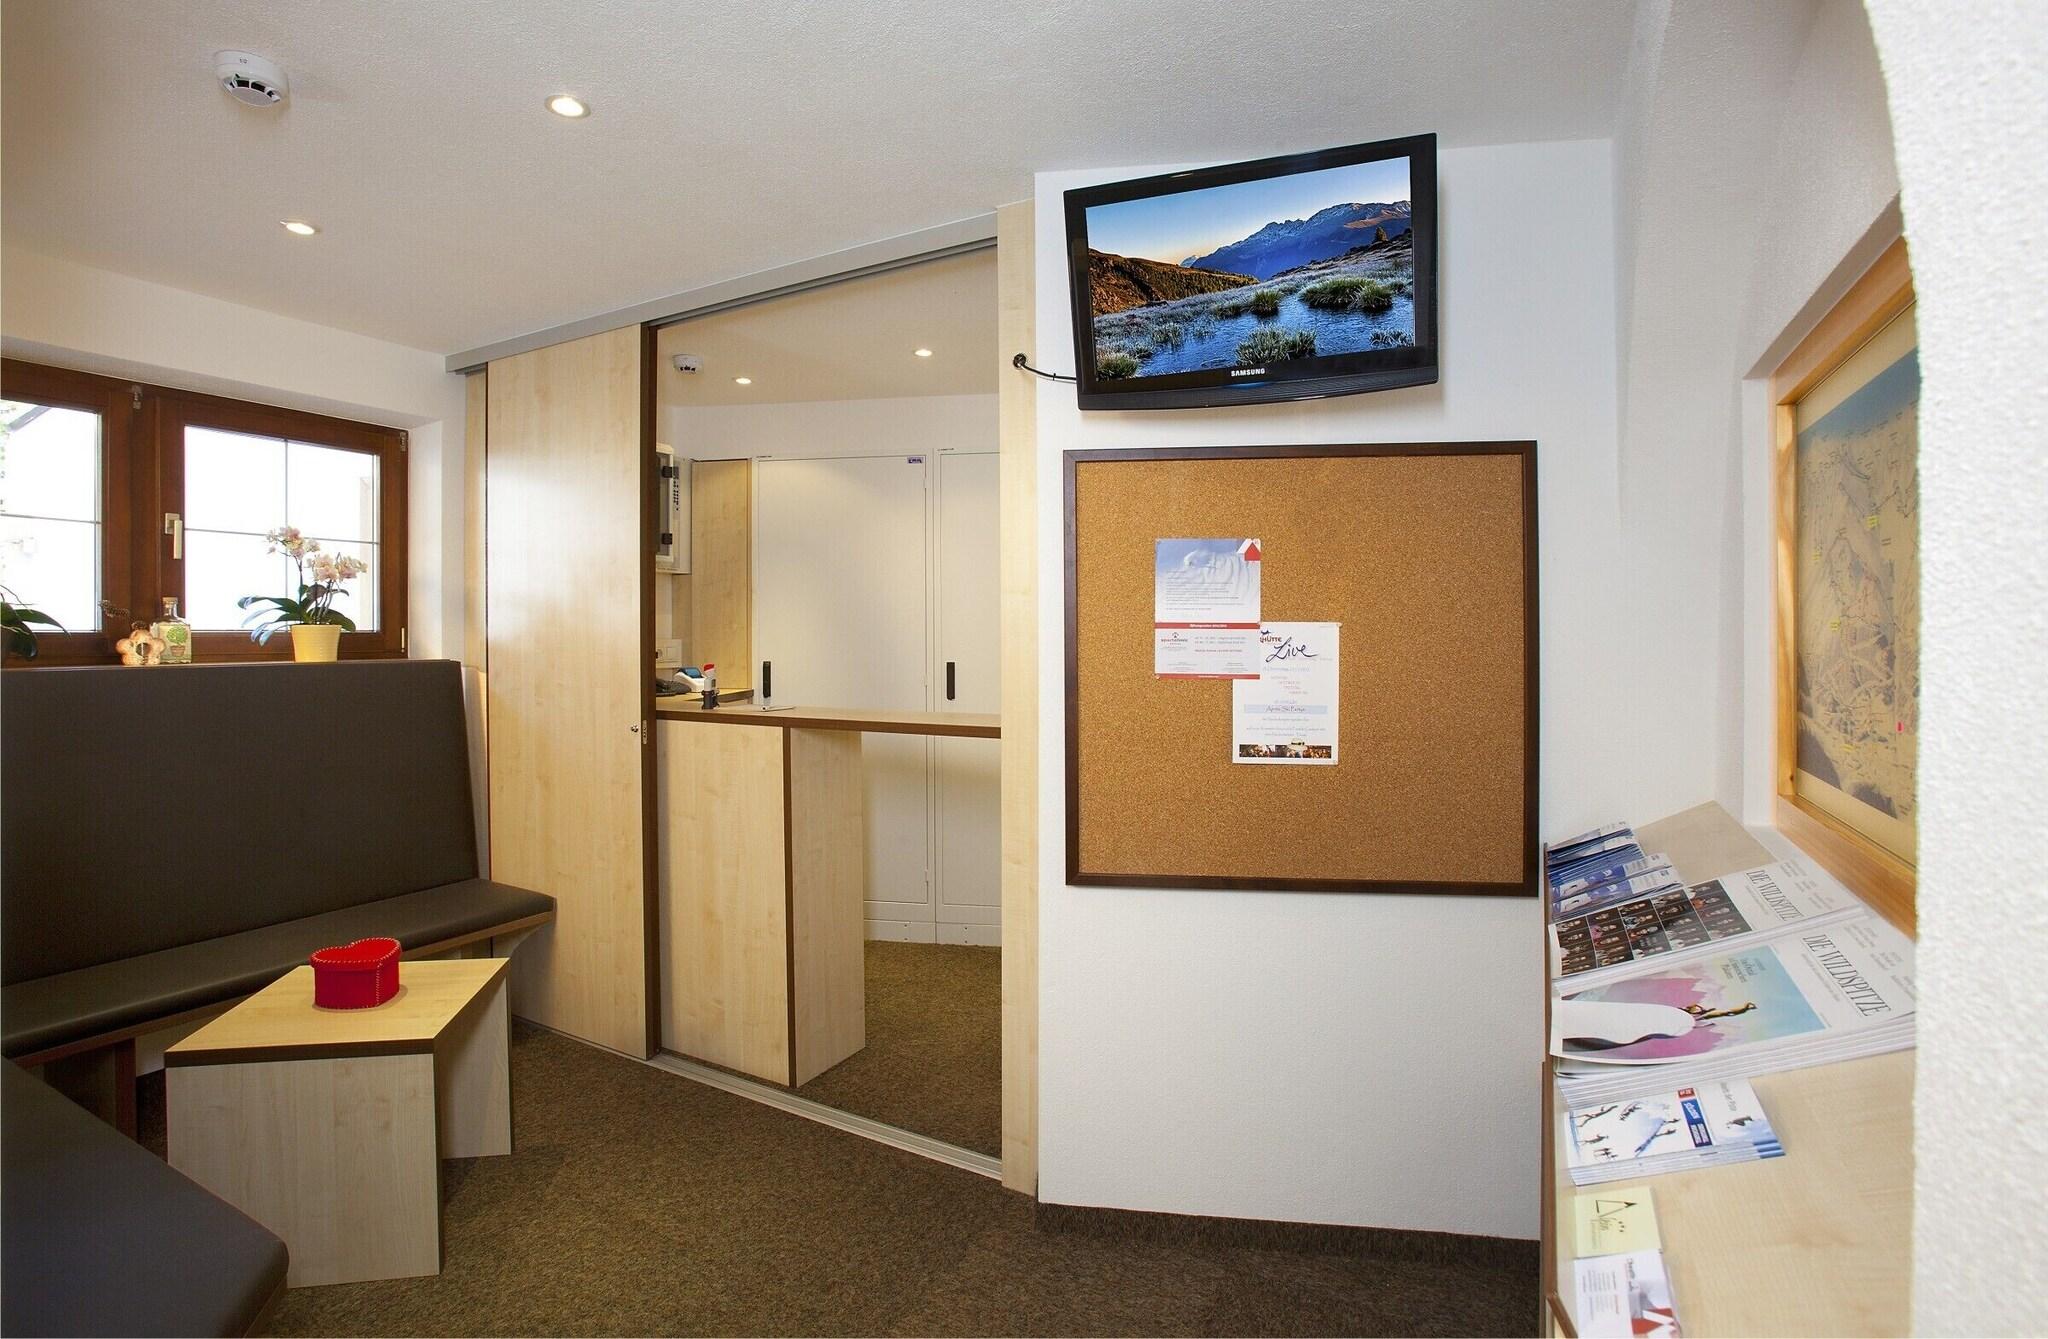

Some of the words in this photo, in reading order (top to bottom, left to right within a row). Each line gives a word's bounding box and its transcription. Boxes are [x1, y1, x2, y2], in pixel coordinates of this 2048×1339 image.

[1231, 368, 1265, 377] SAMSUNG
[1266, 636, 1319, 662] Live
[1802, 934, 1836, 952] DIE
[1817, 950, 1891, 1017] WILDSPITZE
